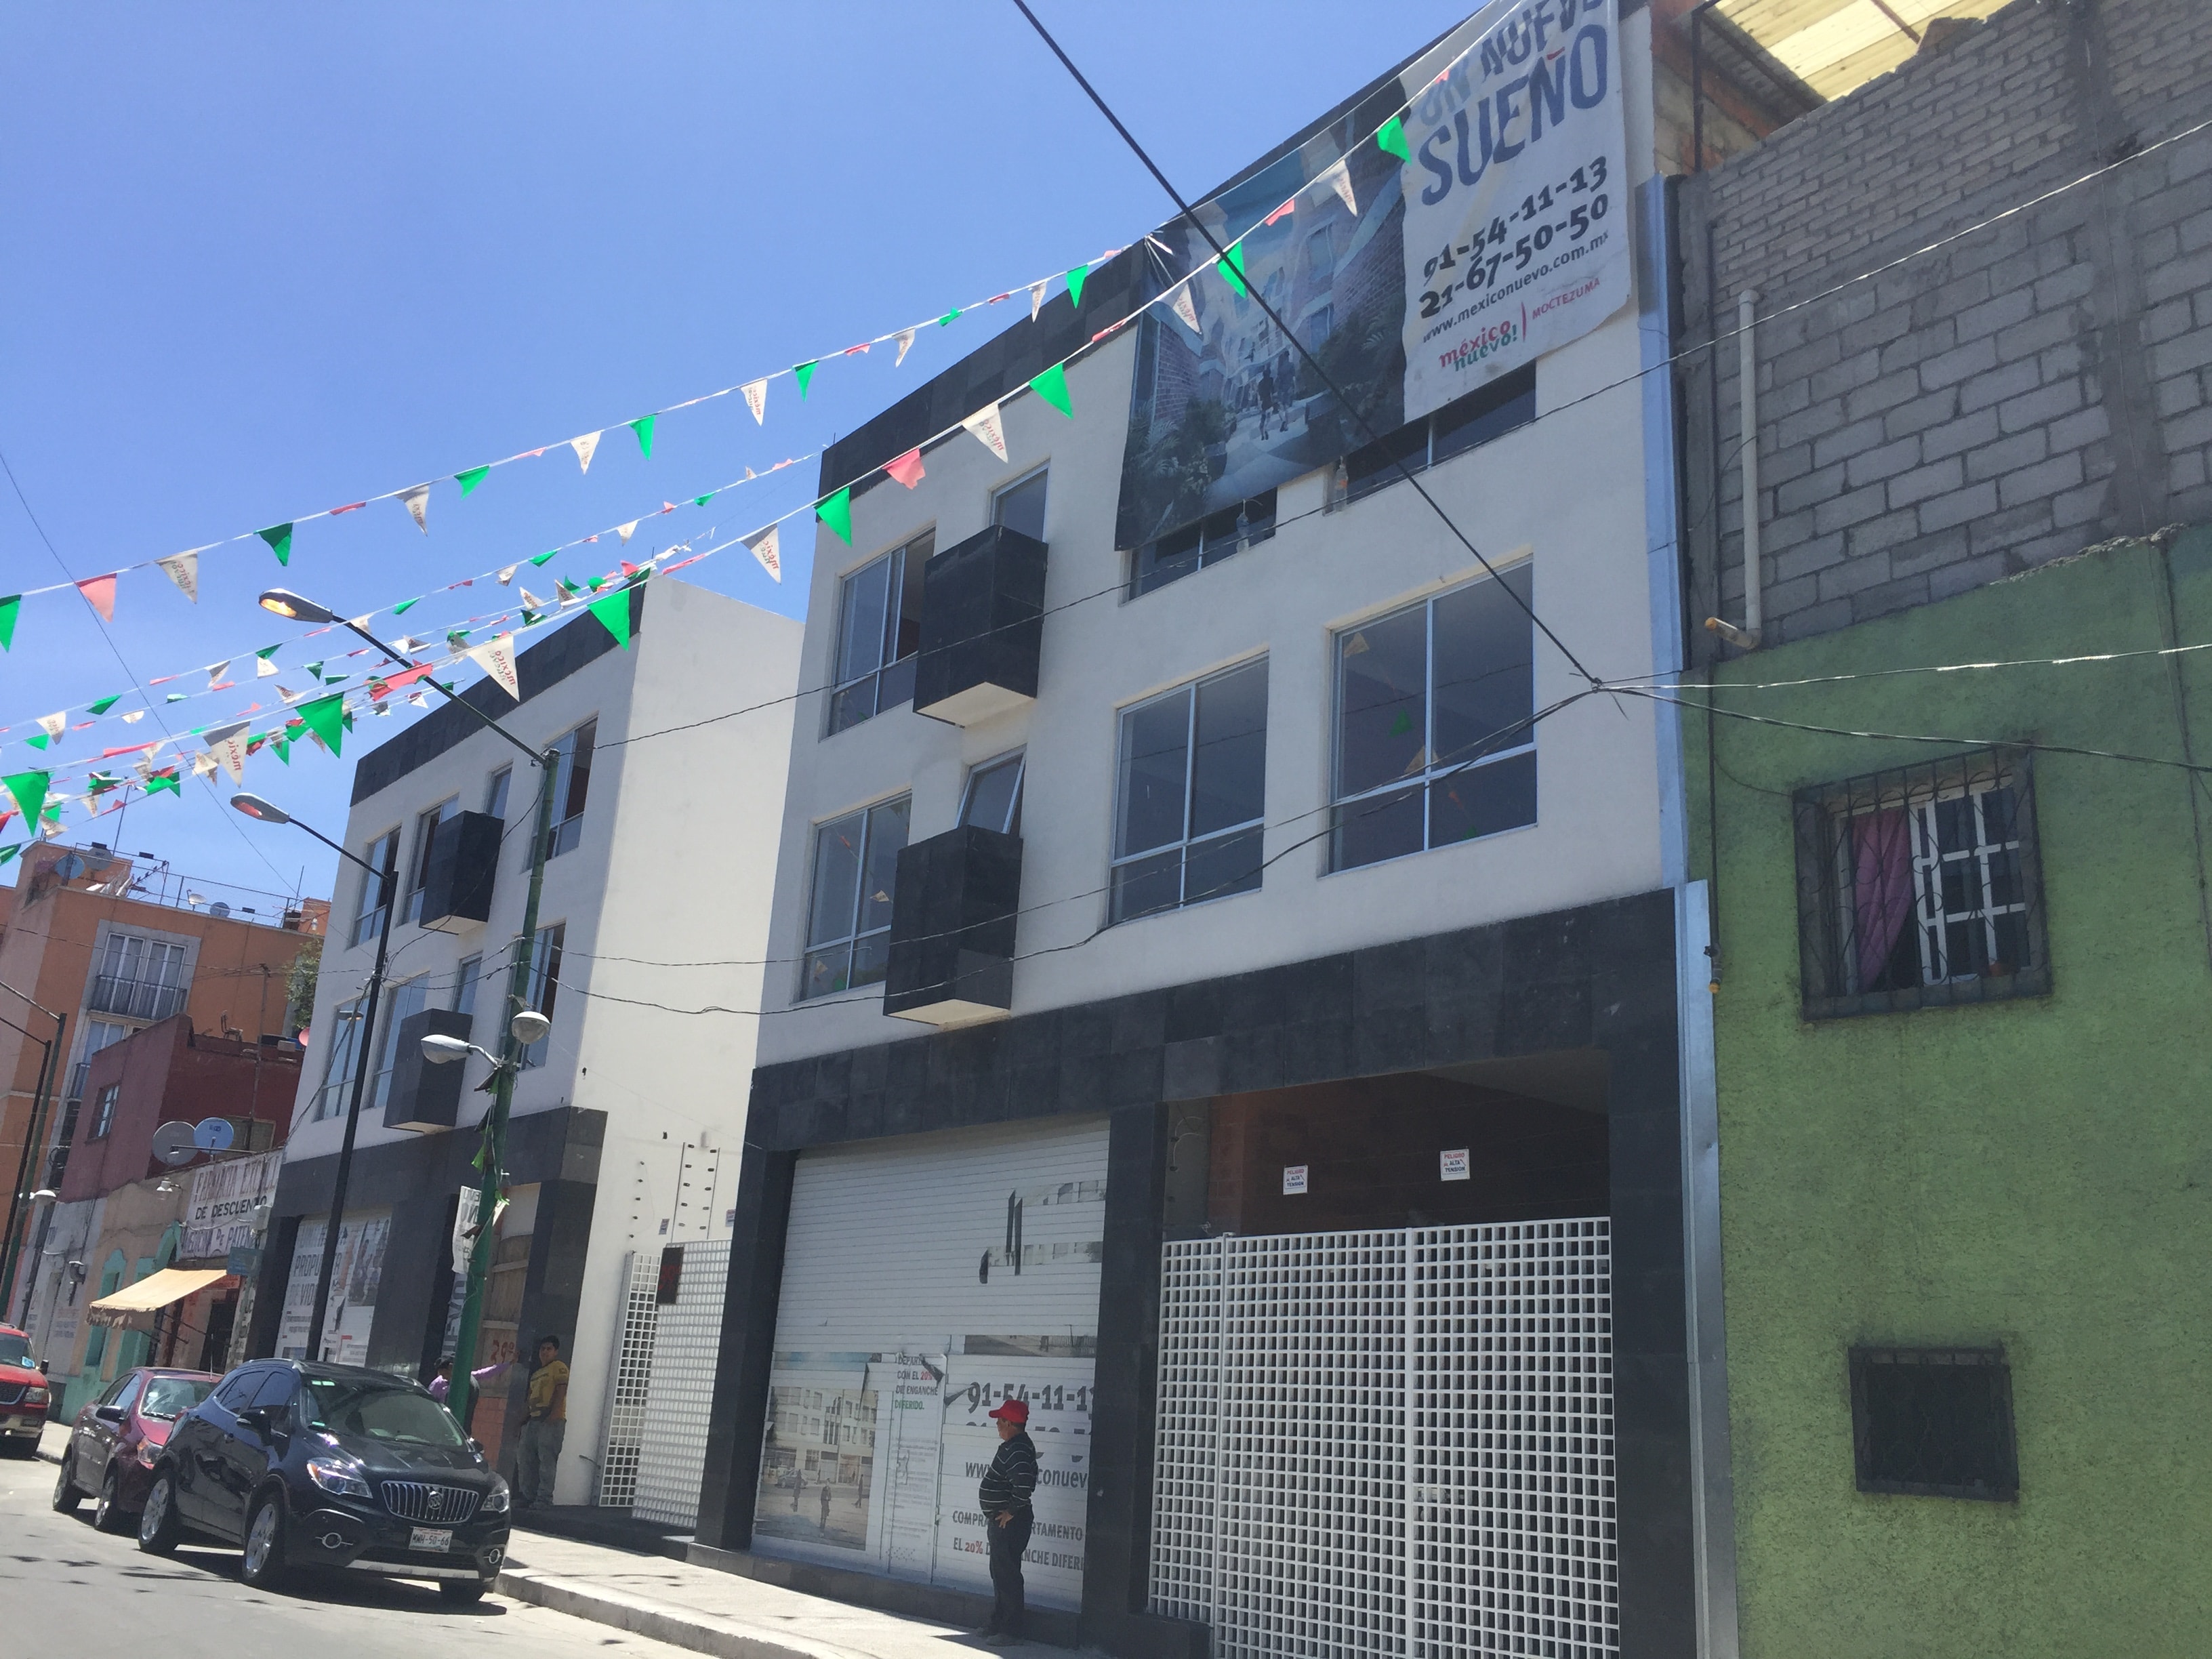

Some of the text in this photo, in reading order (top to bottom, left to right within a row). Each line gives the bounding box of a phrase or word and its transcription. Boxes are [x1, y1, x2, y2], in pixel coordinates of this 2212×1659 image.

[1481, 0, 1603, 82] NUEV
[1418, 24, 1607, 205] SUEÑO
[1423, 156, 1607, 287] 91-54-11-13
[1419, 194, 1608, 319] 21-67-50-50
[1423, 230, 1609, 343] www.mexiconuevo.com.mx
[1532, 278, 1600, 320] MOCTEZUMA
[1439, 320, 1511, 368] méxico
[1454, 325, 1517, 371] nuevo!
[195, 1206, 208, 1221] DE
[895, 1385, 939, 1396] DE ENGANCHE
[897, 1370, 911, 1380] CON
[912, 1371, 920, 1380] EL
[953, 1537, 963, 1551] EL
[965, 1540, 983, 1555] 20%
